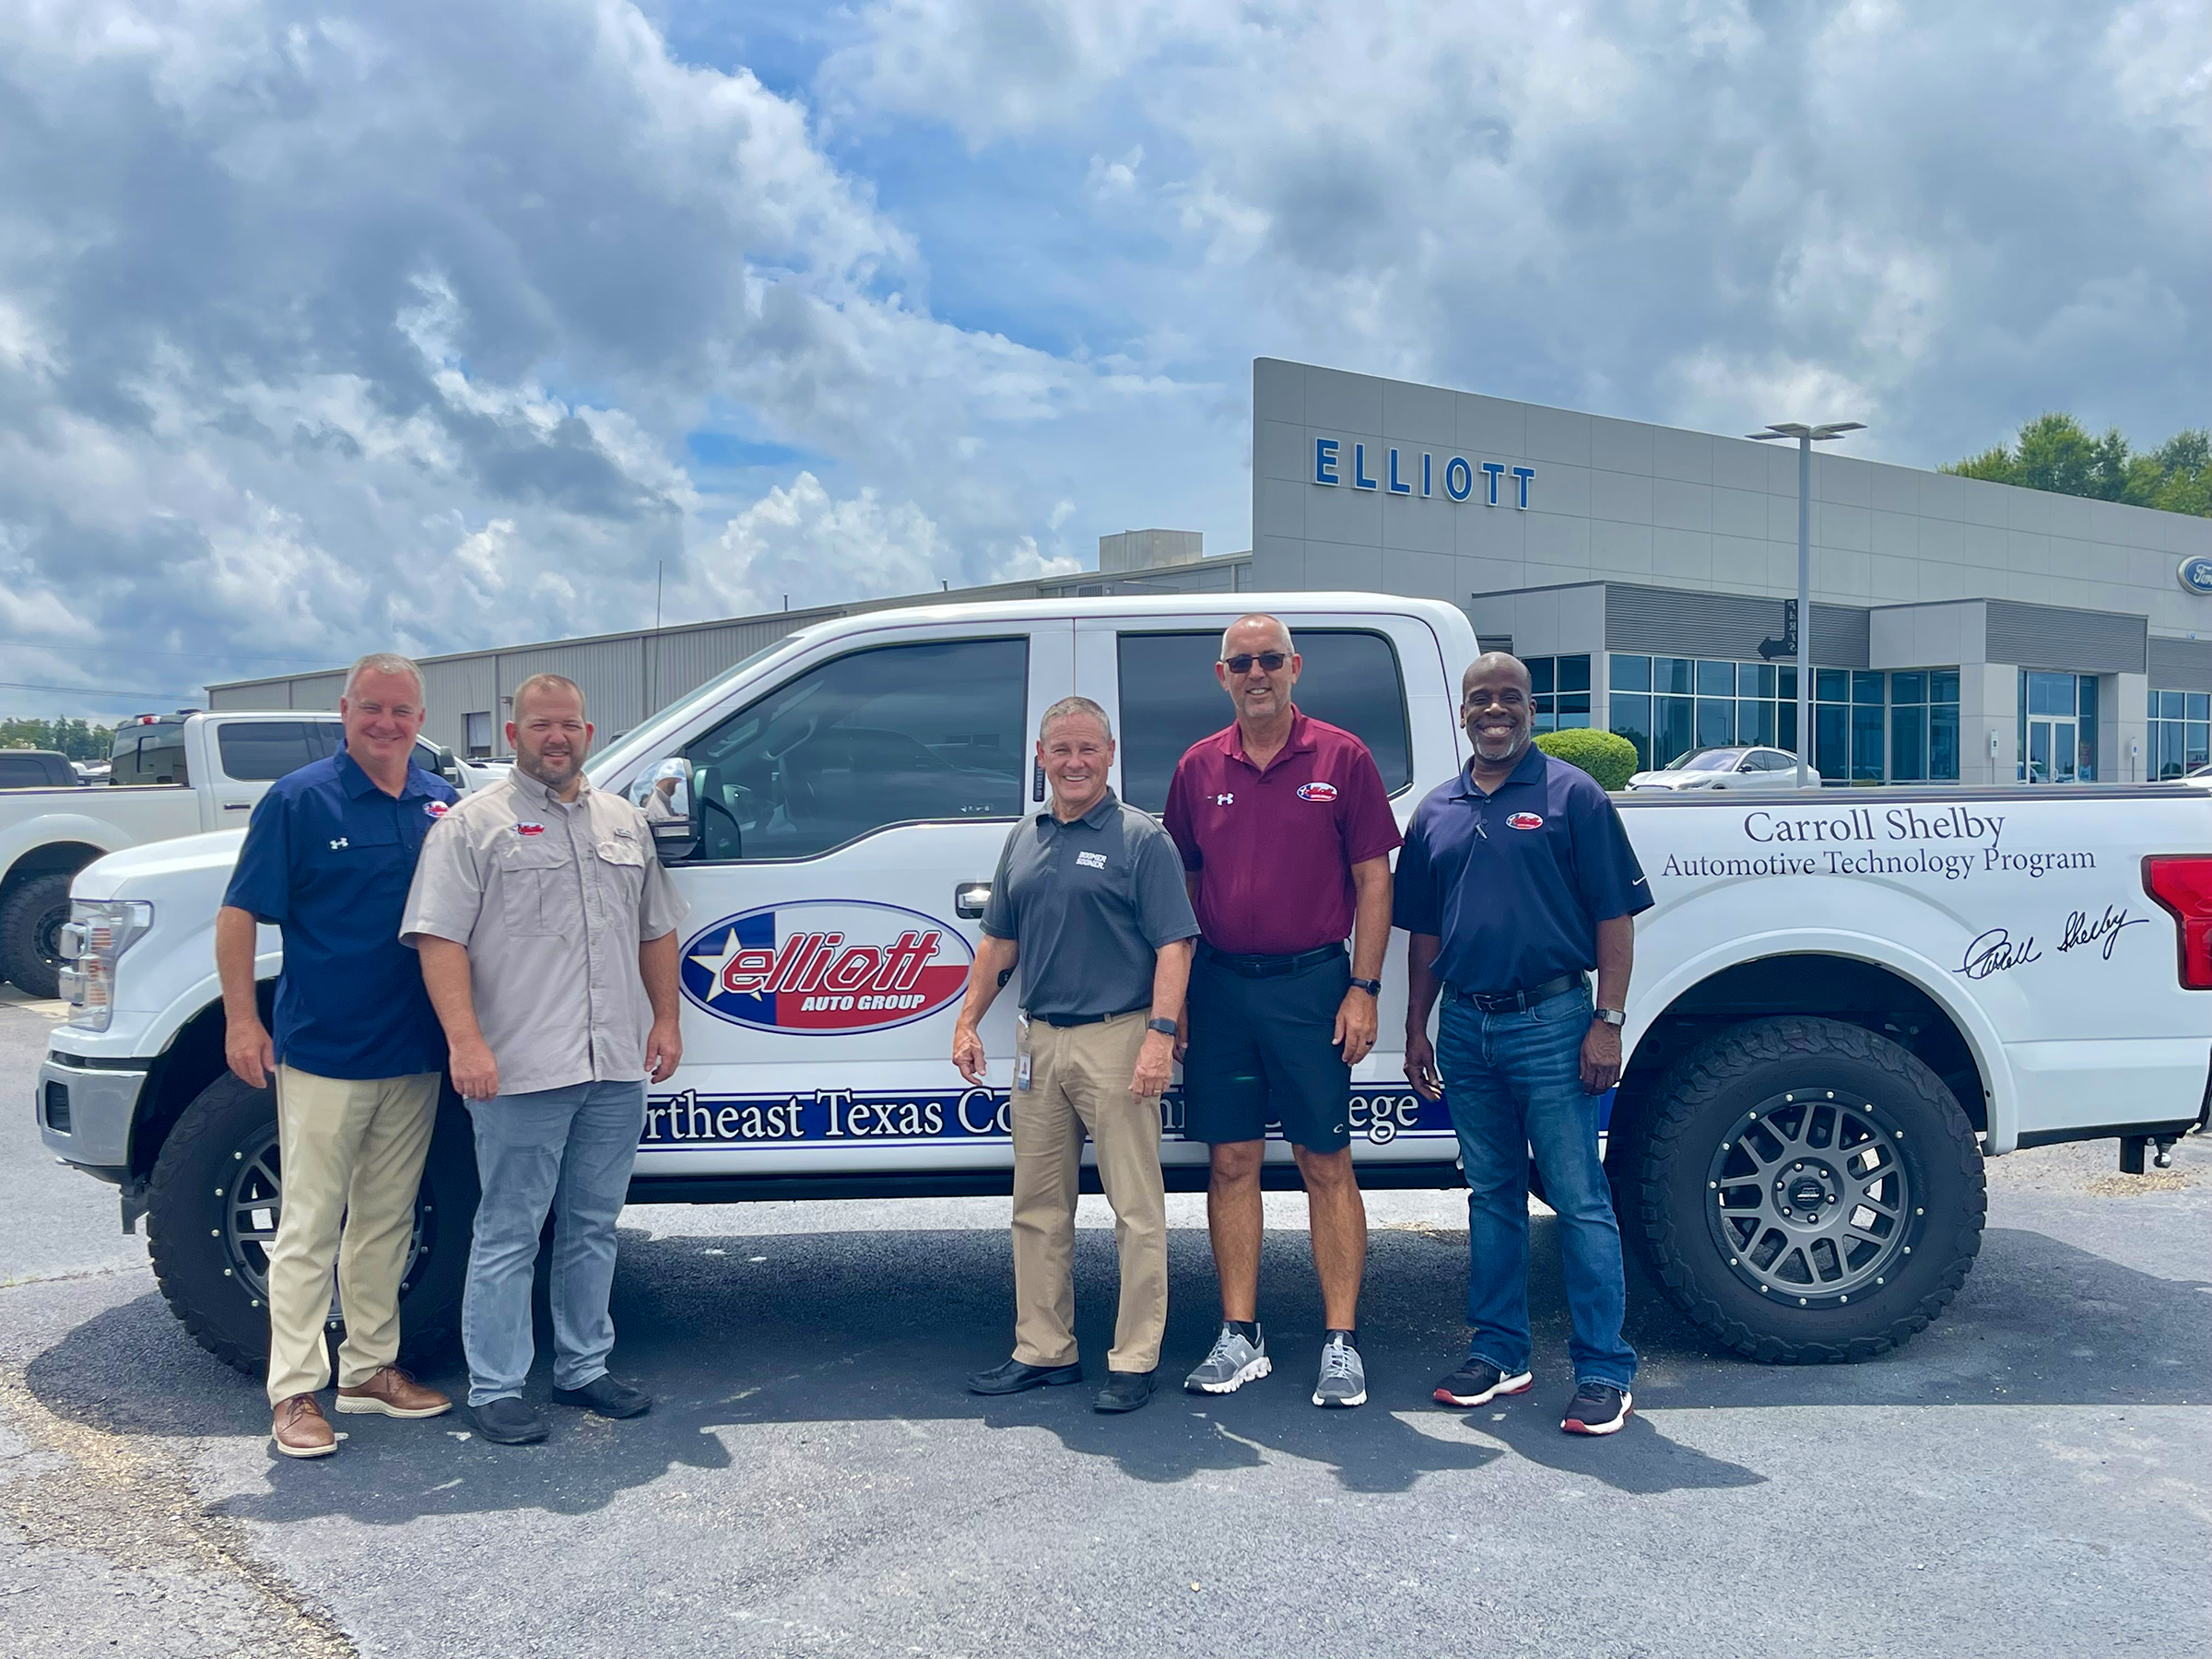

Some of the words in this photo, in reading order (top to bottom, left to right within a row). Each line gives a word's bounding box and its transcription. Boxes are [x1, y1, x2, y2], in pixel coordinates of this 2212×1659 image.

[1312, 437, 1535, 511] ELLIOTT
[2194, 563, 2212, 584] For
[1744, 808, 1877, 842] Carroll
[1886, 806, 2006, 849] Shelby
[1078, 851, 1107, 863] BOOMER
[1662, 853, 1816, 877] Automotive
[1823, 848, 1975, 880] Technology
[1983, 847, 2097, 878] Program
[2056, 904, 2150, 960] Shelby
[721, 931, 941, 994] elliott
[800, 995, 853, 1011] AUTO
[857, 994, 926, 1010] GROUP
[816, 1088, 944, 1136] Texas
